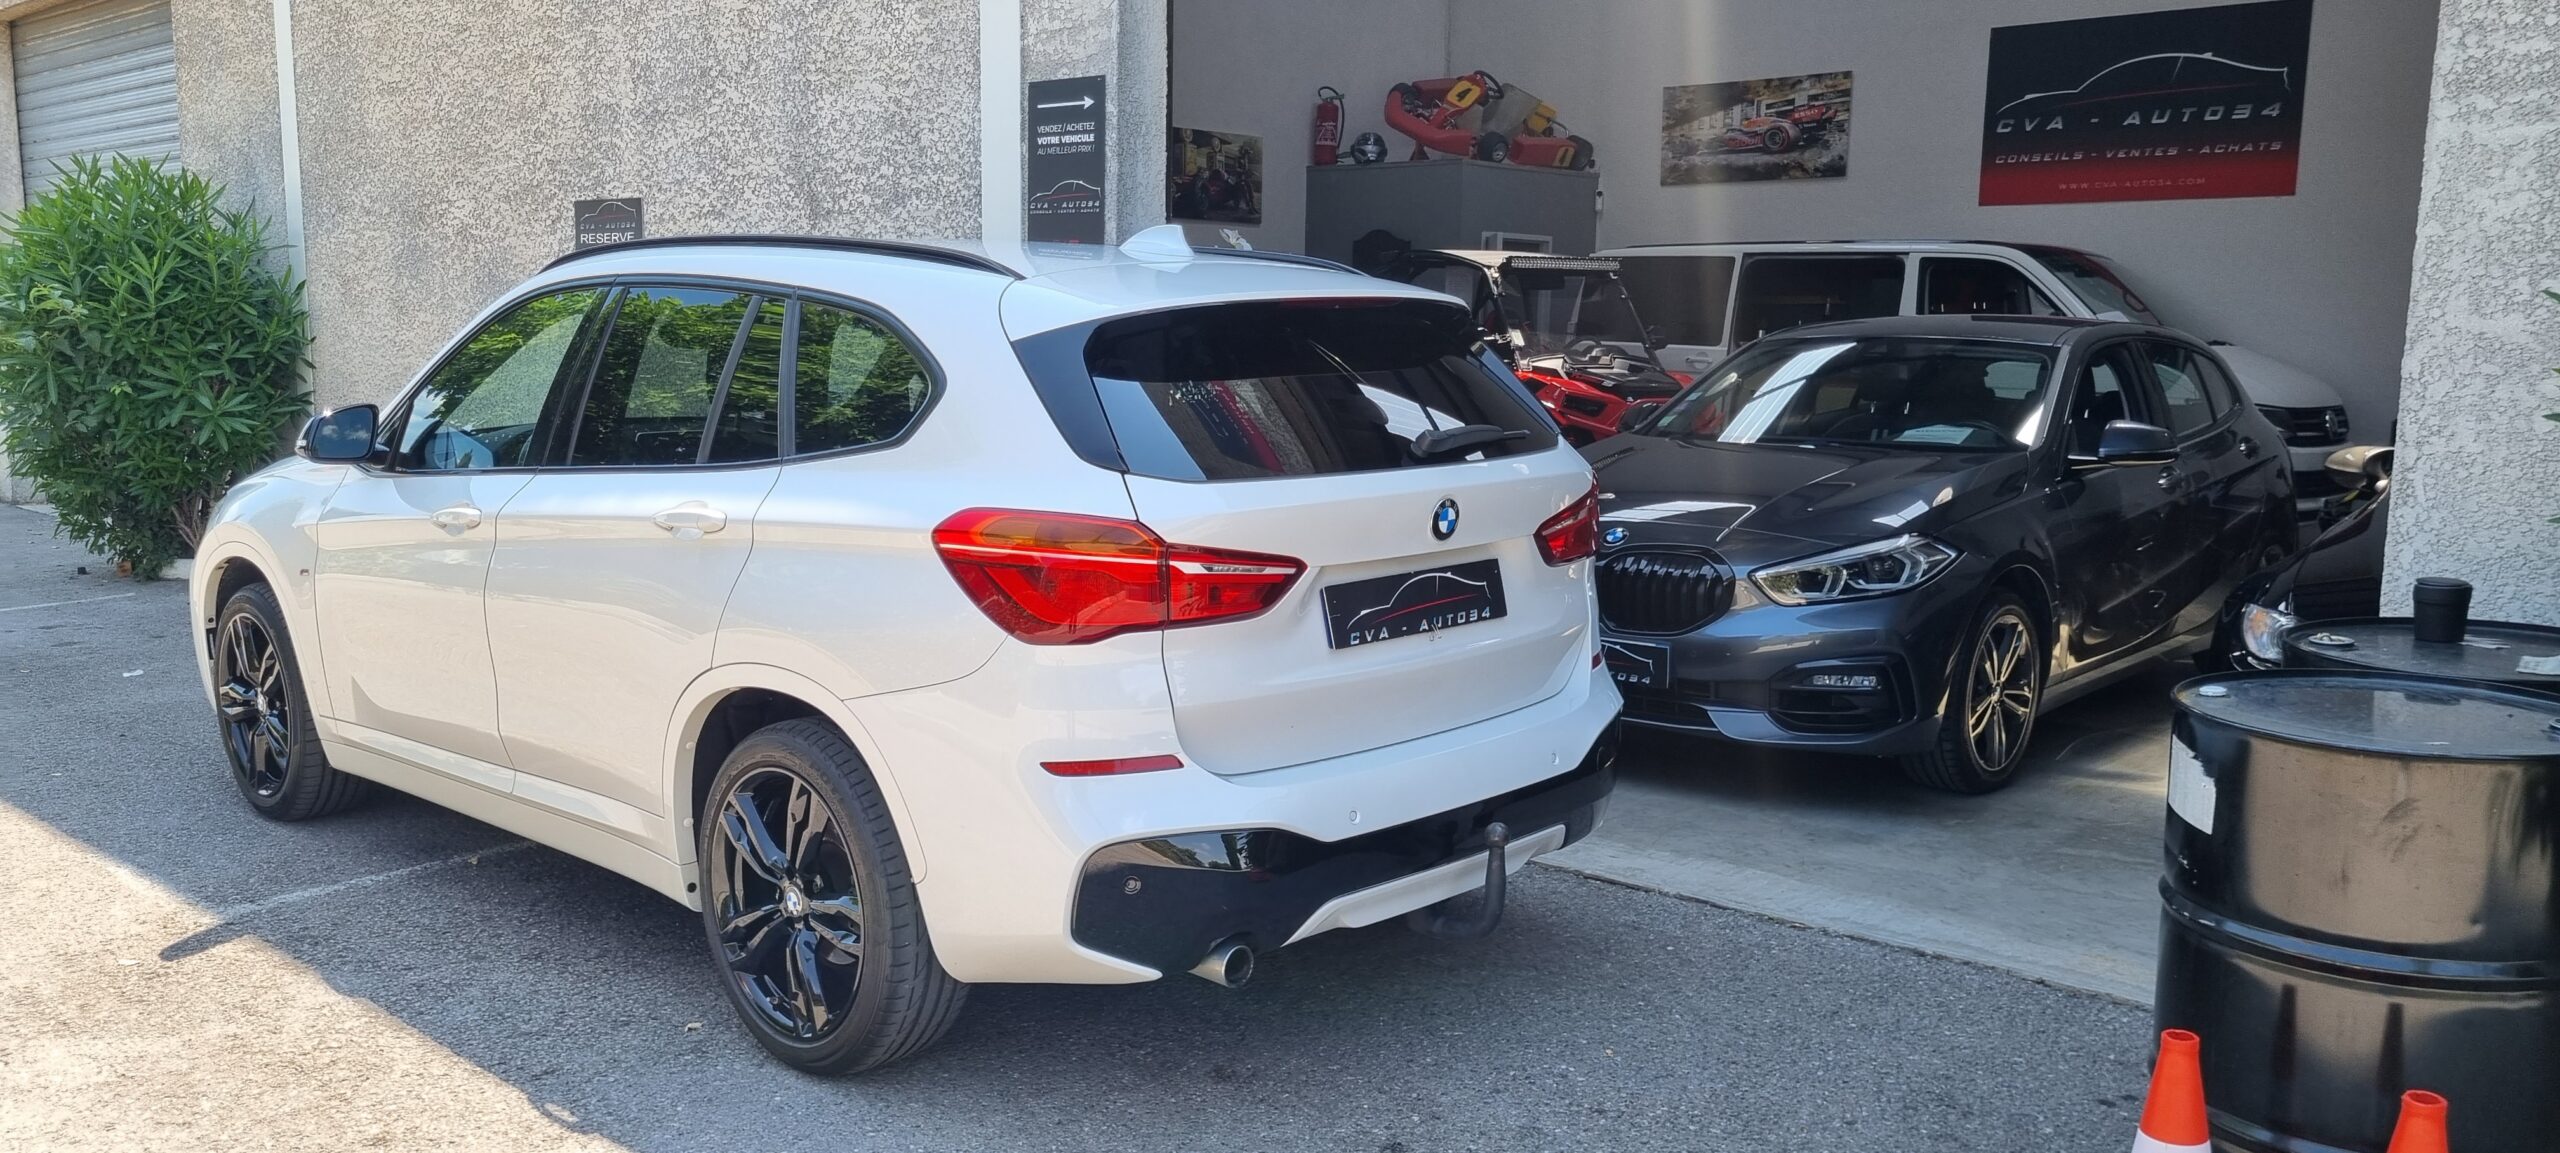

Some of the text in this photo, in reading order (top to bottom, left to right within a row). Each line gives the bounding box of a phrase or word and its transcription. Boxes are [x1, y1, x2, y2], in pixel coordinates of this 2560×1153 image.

[1456, 88, 1473, 102] 4
[1996, 116, 2063, 133] CVA
[2122, 102, 2282, 126] AUTO34
[1037, 133, 1095, 145] VOTRE VEHICULE
[1037, 147, 1046, 155] AU
[1047, 145, 1077, 155] MEILLEUR
[1995, 152, 2083, 164] CONSEILS
[2106, 147, 2179, 158] VENTES
[2200, 142, 2283, 153] ACHATS
[1062, 200, 1100, 208] AUTO34
[1350, 626, 1389, 645] CVA
[1420, 606, 1490, 631] AUTO34
